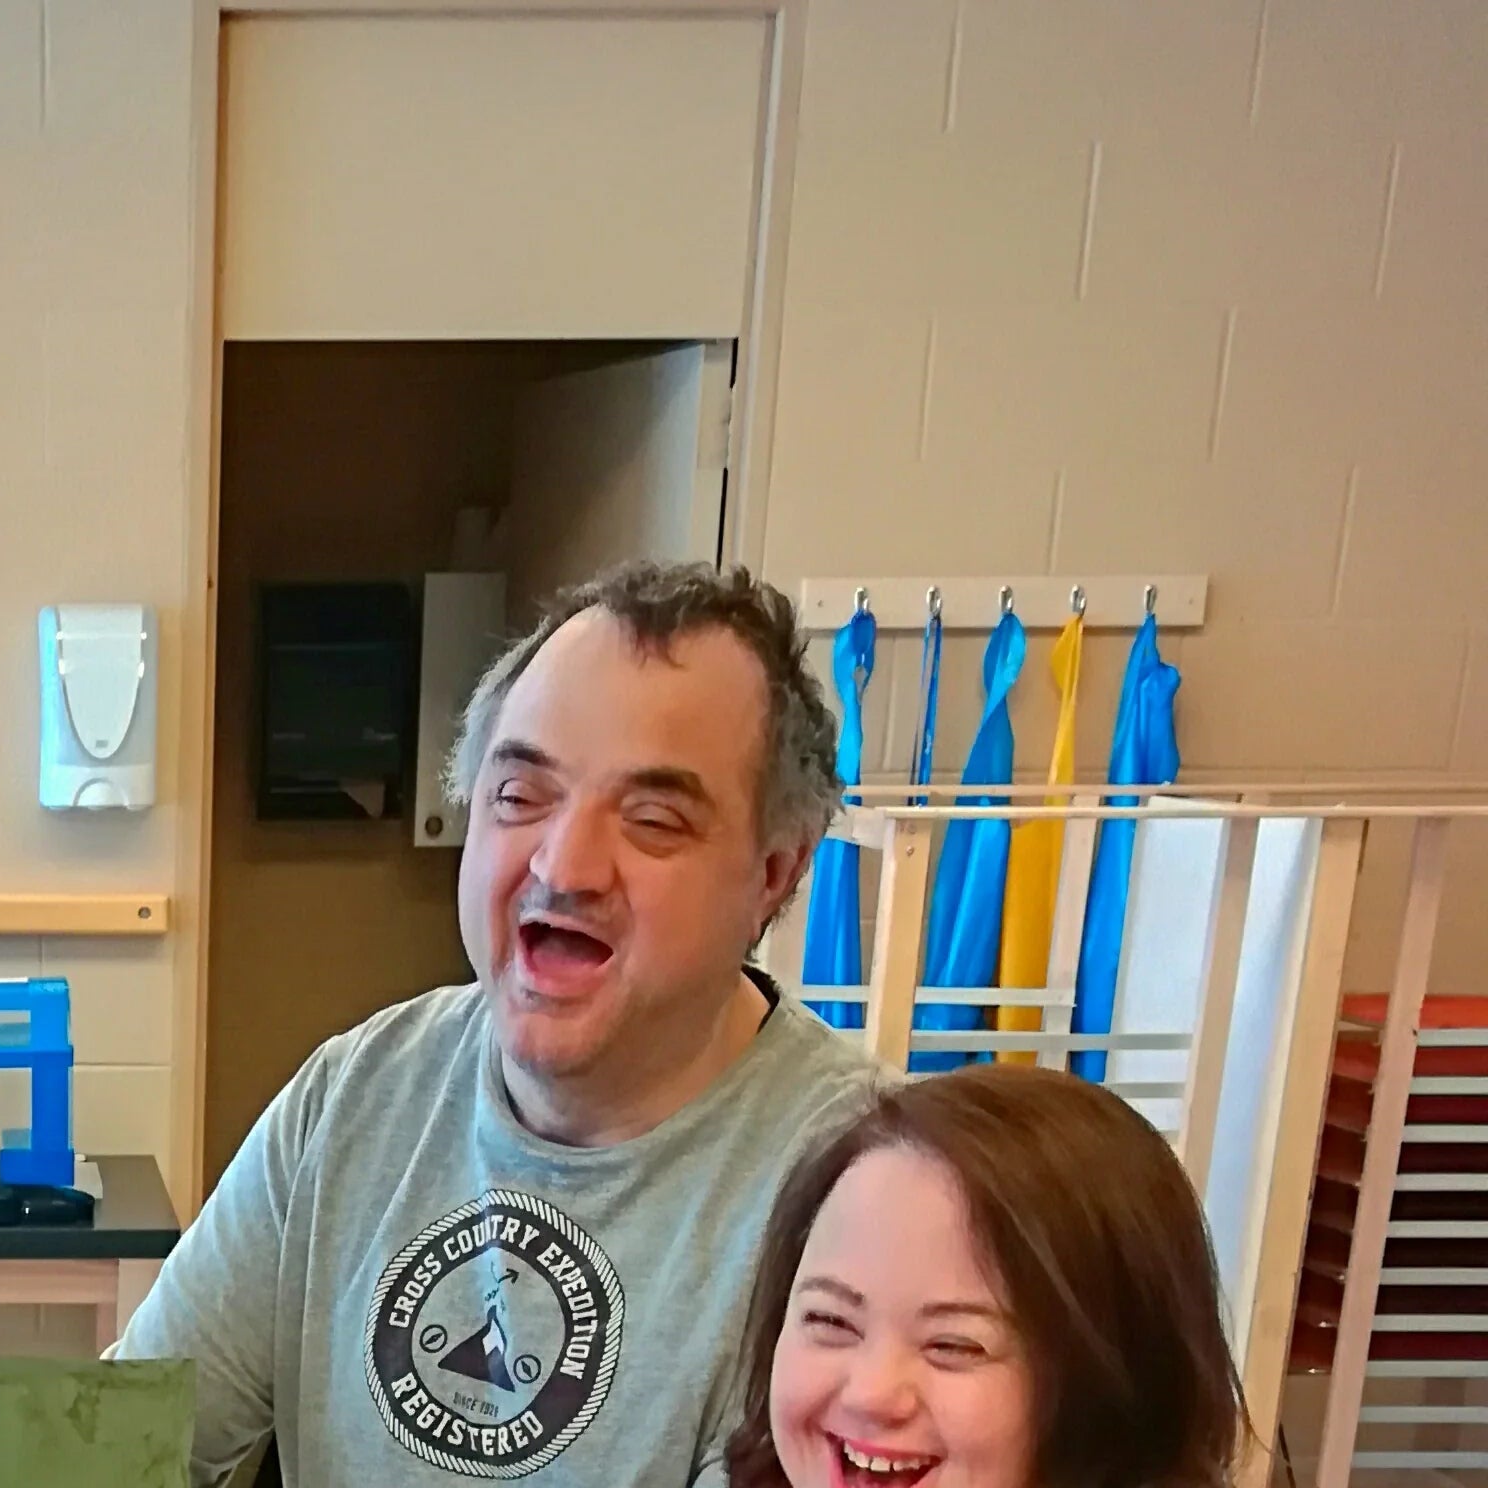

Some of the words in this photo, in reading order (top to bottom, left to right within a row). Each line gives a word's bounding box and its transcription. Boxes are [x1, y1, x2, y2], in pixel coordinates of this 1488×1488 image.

[389, 1252, 442, 1329] CROSS
[536, 1242, 598, 1379] EXPEDITION
[392, 1372, 543, 1456] REGISTERED
